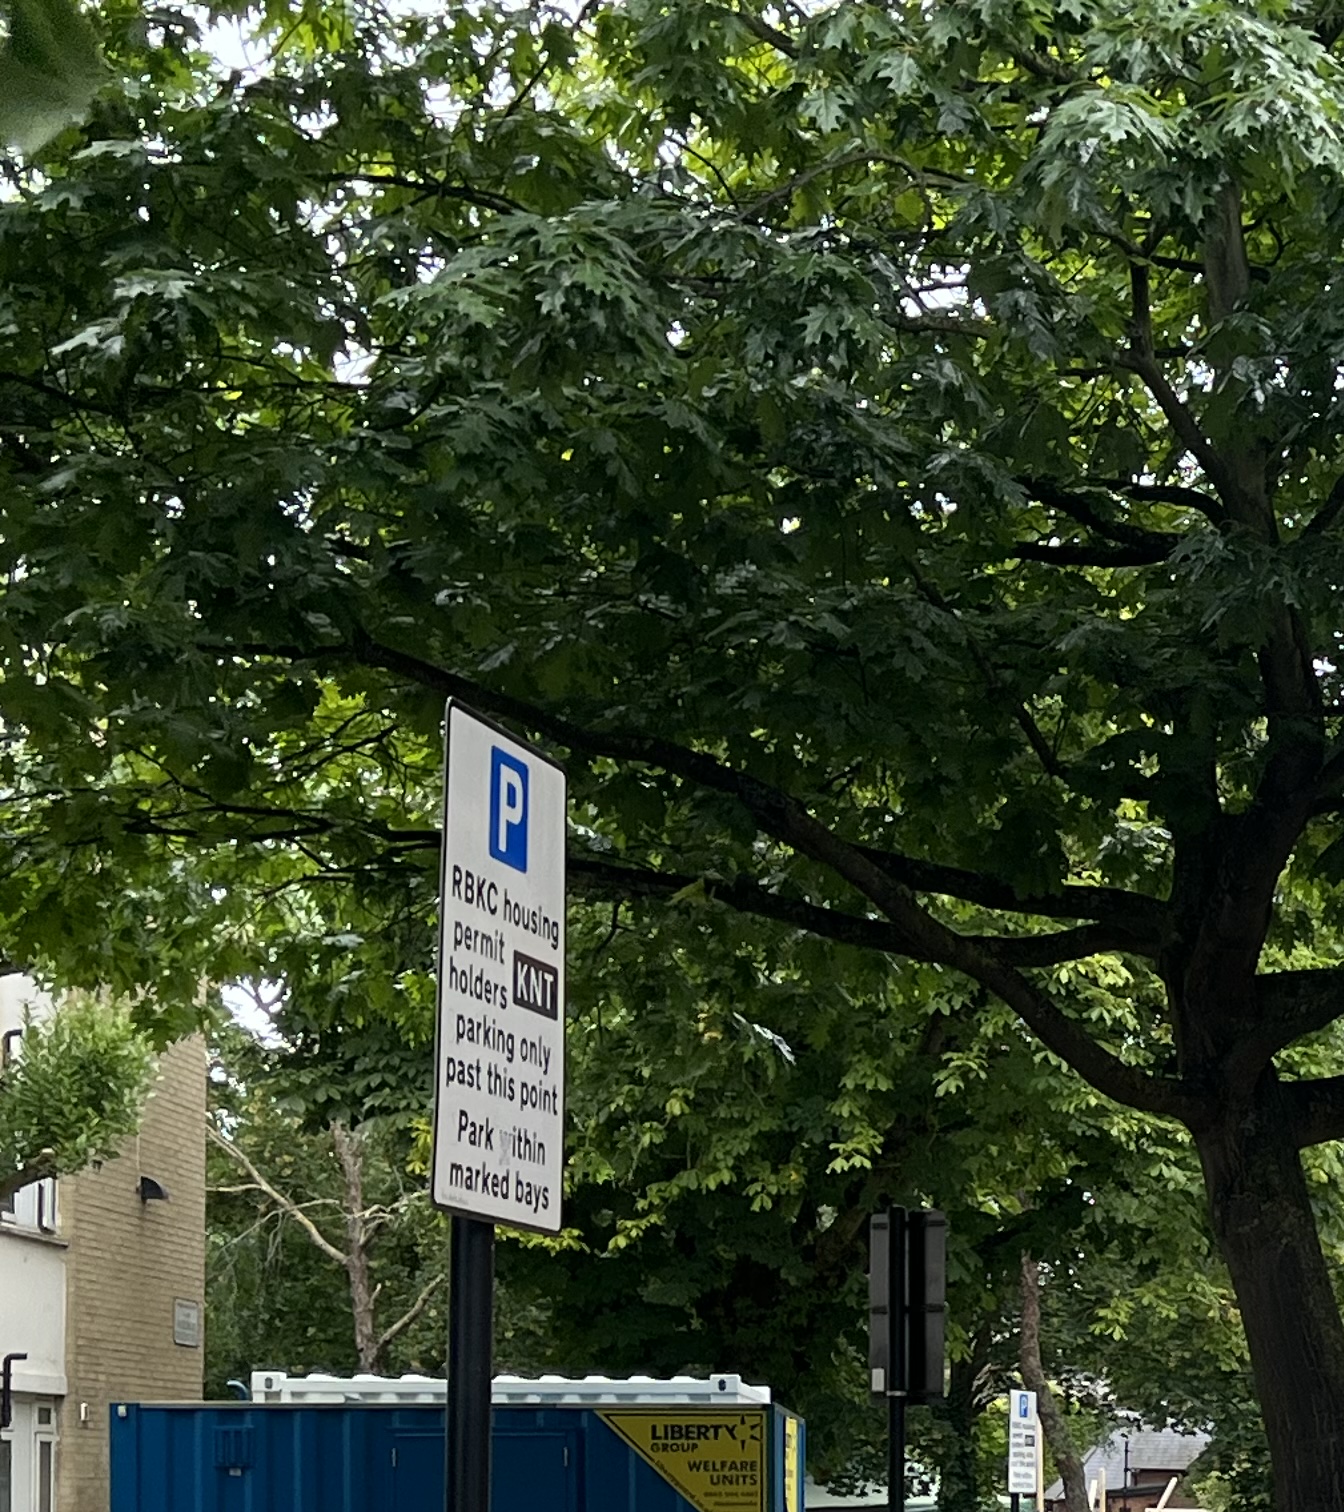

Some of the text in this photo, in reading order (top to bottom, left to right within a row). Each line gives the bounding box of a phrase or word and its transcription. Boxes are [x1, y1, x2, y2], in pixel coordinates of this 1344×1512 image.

[498, 762, 524, 853] P
[452, 863, 559, 950] RBKC housing
[453, 920, 505, 965] permit
[449, 955, 554, 1011] holders KNT
[456, 1013, 551, 1075] parking only
[446, 1056, 558, 1116] past this point
[457, 1108, 546, 1166] Park ithin
[449, 1160, 549, 1214] marked bays
[650, 1423, 738, 1441] LIBERTY
[650, 1442, 699, 1453] GROUP
[687, 1460, 758, 1473] WELFARE
[709, 1473, 758, 1486] UNITS
